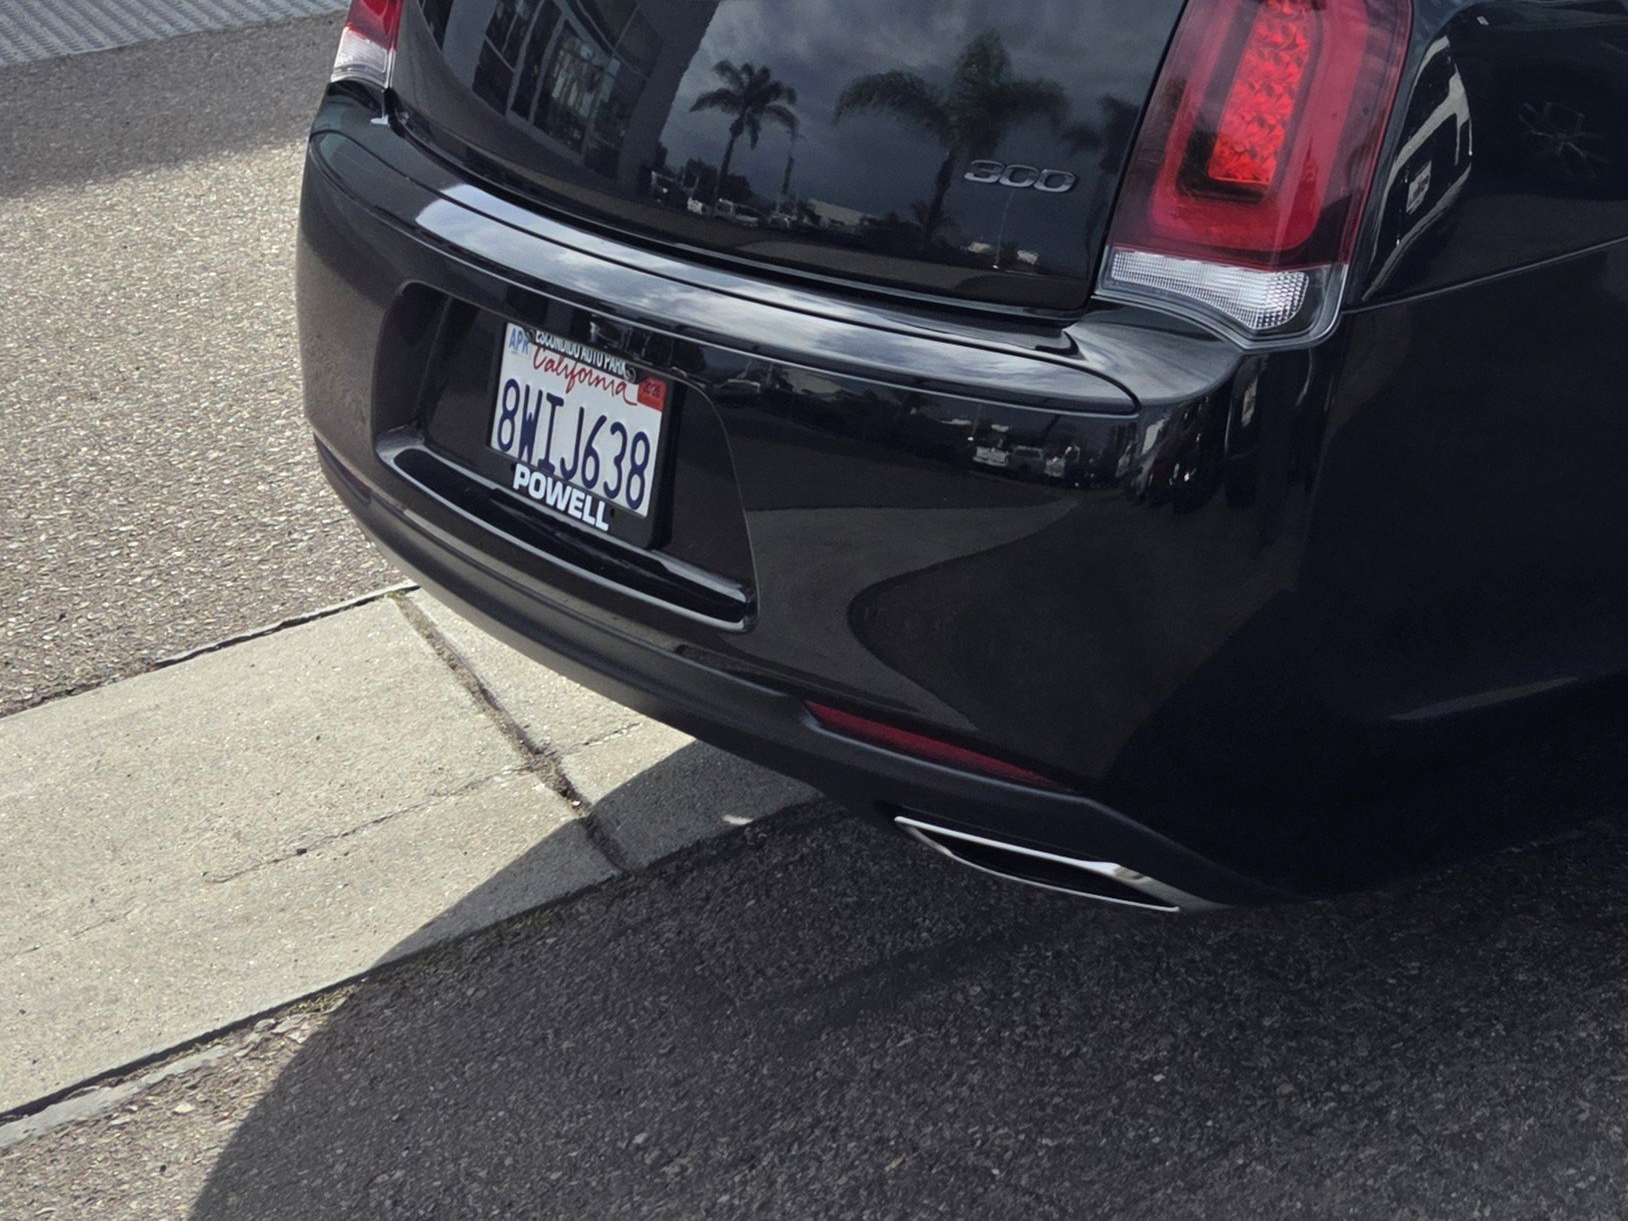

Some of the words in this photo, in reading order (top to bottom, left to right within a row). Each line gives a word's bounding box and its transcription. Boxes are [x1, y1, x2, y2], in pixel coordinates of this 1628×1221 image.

[964, 159, 1076, 192] 300
[508, 327, 530, 355] APR
[535, 329, 580, 359] ESCONDIDO
[580, 344, 603, 367] AUTO
[602, 354, 627, 376] PARK
[533, 346, 638, 407] California
[497, 378, 650, 511] 8WIJ638
[513, 463, 609, 531] POWELL
